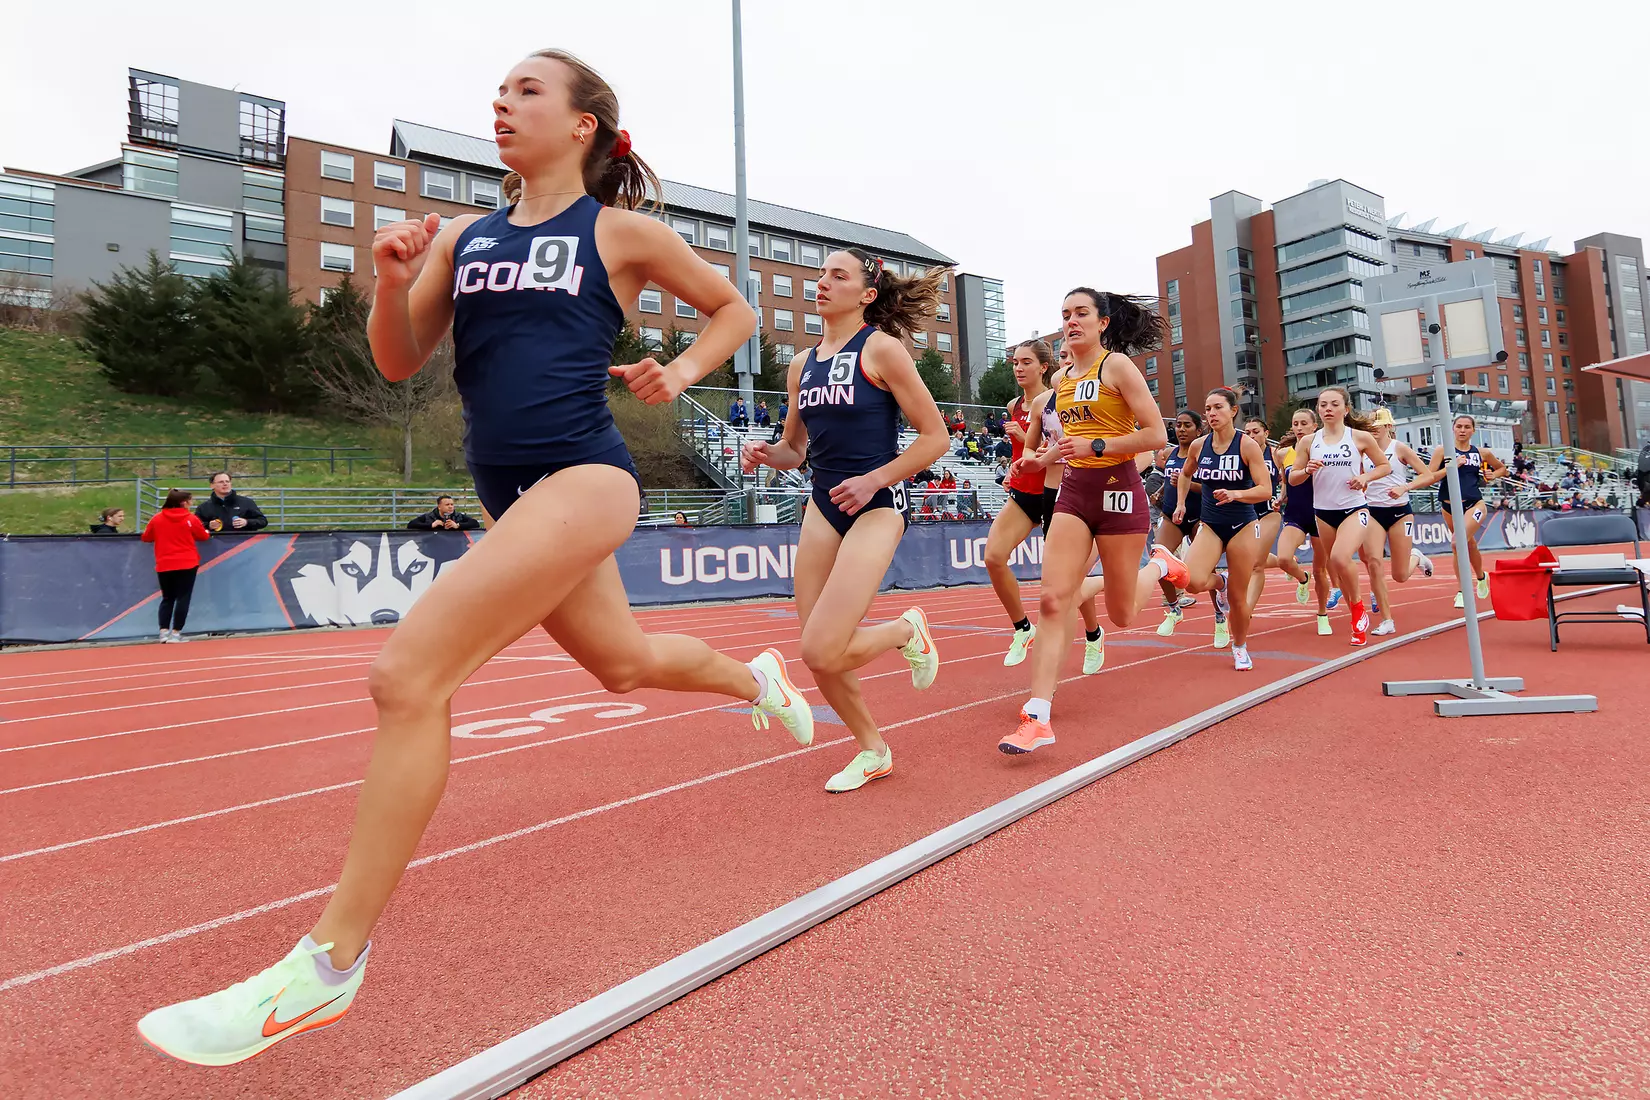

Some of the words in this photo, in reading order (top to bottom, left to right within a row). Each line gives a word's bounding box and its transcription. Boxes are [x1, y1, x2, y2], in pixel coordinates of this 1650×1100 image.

[533, 239, 570, 283] 9
[832, 354, 852, 382] 5
[1079, 380, 1095, 399] 10
[1059, 404, 1095, 424] ONA
[1340, 444, 1352, 458] 3
[1221, 456, 1235, 470] 11
[1198, 468, 1244, 481] CONN
[894, 488, 905, 510] 5
[1108, 492, 1129, 512] 10
[1360, 512, 1367, 526] 3
[1474, 512, 1482, 521] 4
[1405, 522, 1413, 536] 7
[660, 544, 798, 585] UCON
